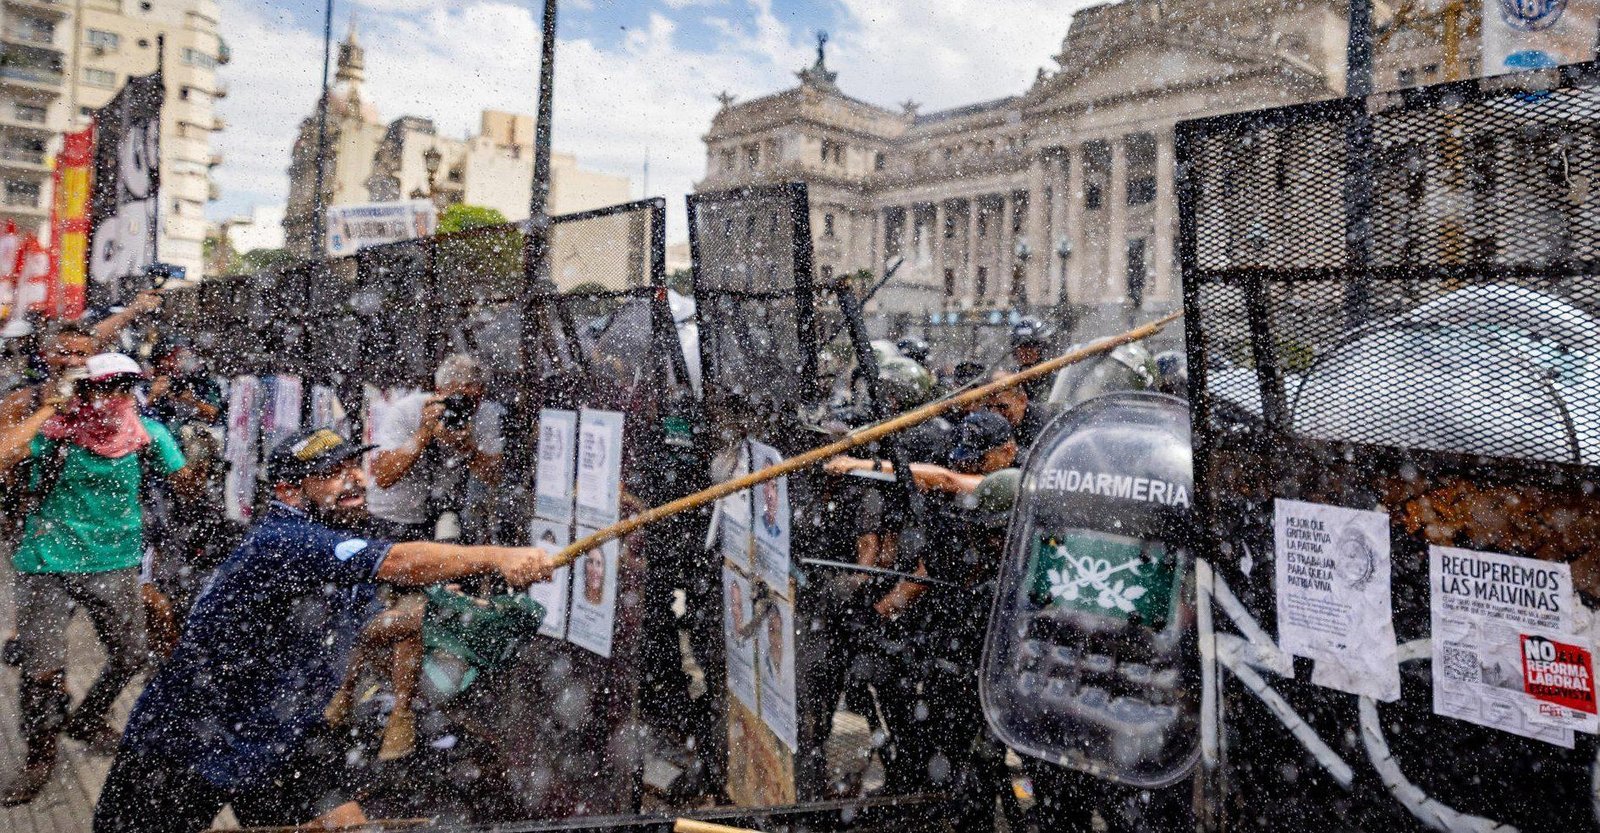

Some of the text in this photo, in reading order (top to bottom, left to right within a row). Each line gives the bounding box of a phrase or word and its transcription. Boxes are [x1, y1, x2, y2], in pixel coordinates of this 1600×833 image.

[1286, 517, 1324, 531] MEJOR QUE
[1286, 528, 1331, 544] GRITAR VIVA
[1287, 540, 1323, 554] LA PATRIA
[1287, 552, 1336, 570] ES TRABAJAR
[1287, 564, 1307, 575] PARA
[1442, 555, 1559, 591] RECUPEREMOS
[1287, 576, 1332, 593] PATRIA VIVA
[1441, 576, 1471, 597] LAS
[1474, 581, 1560, 612] MALVINAS
[1524, 639, 1557, 662] NO
[1527, 660, 1590, 678] REFORMA
[1528, 671, 1591, 691] LABORAL
